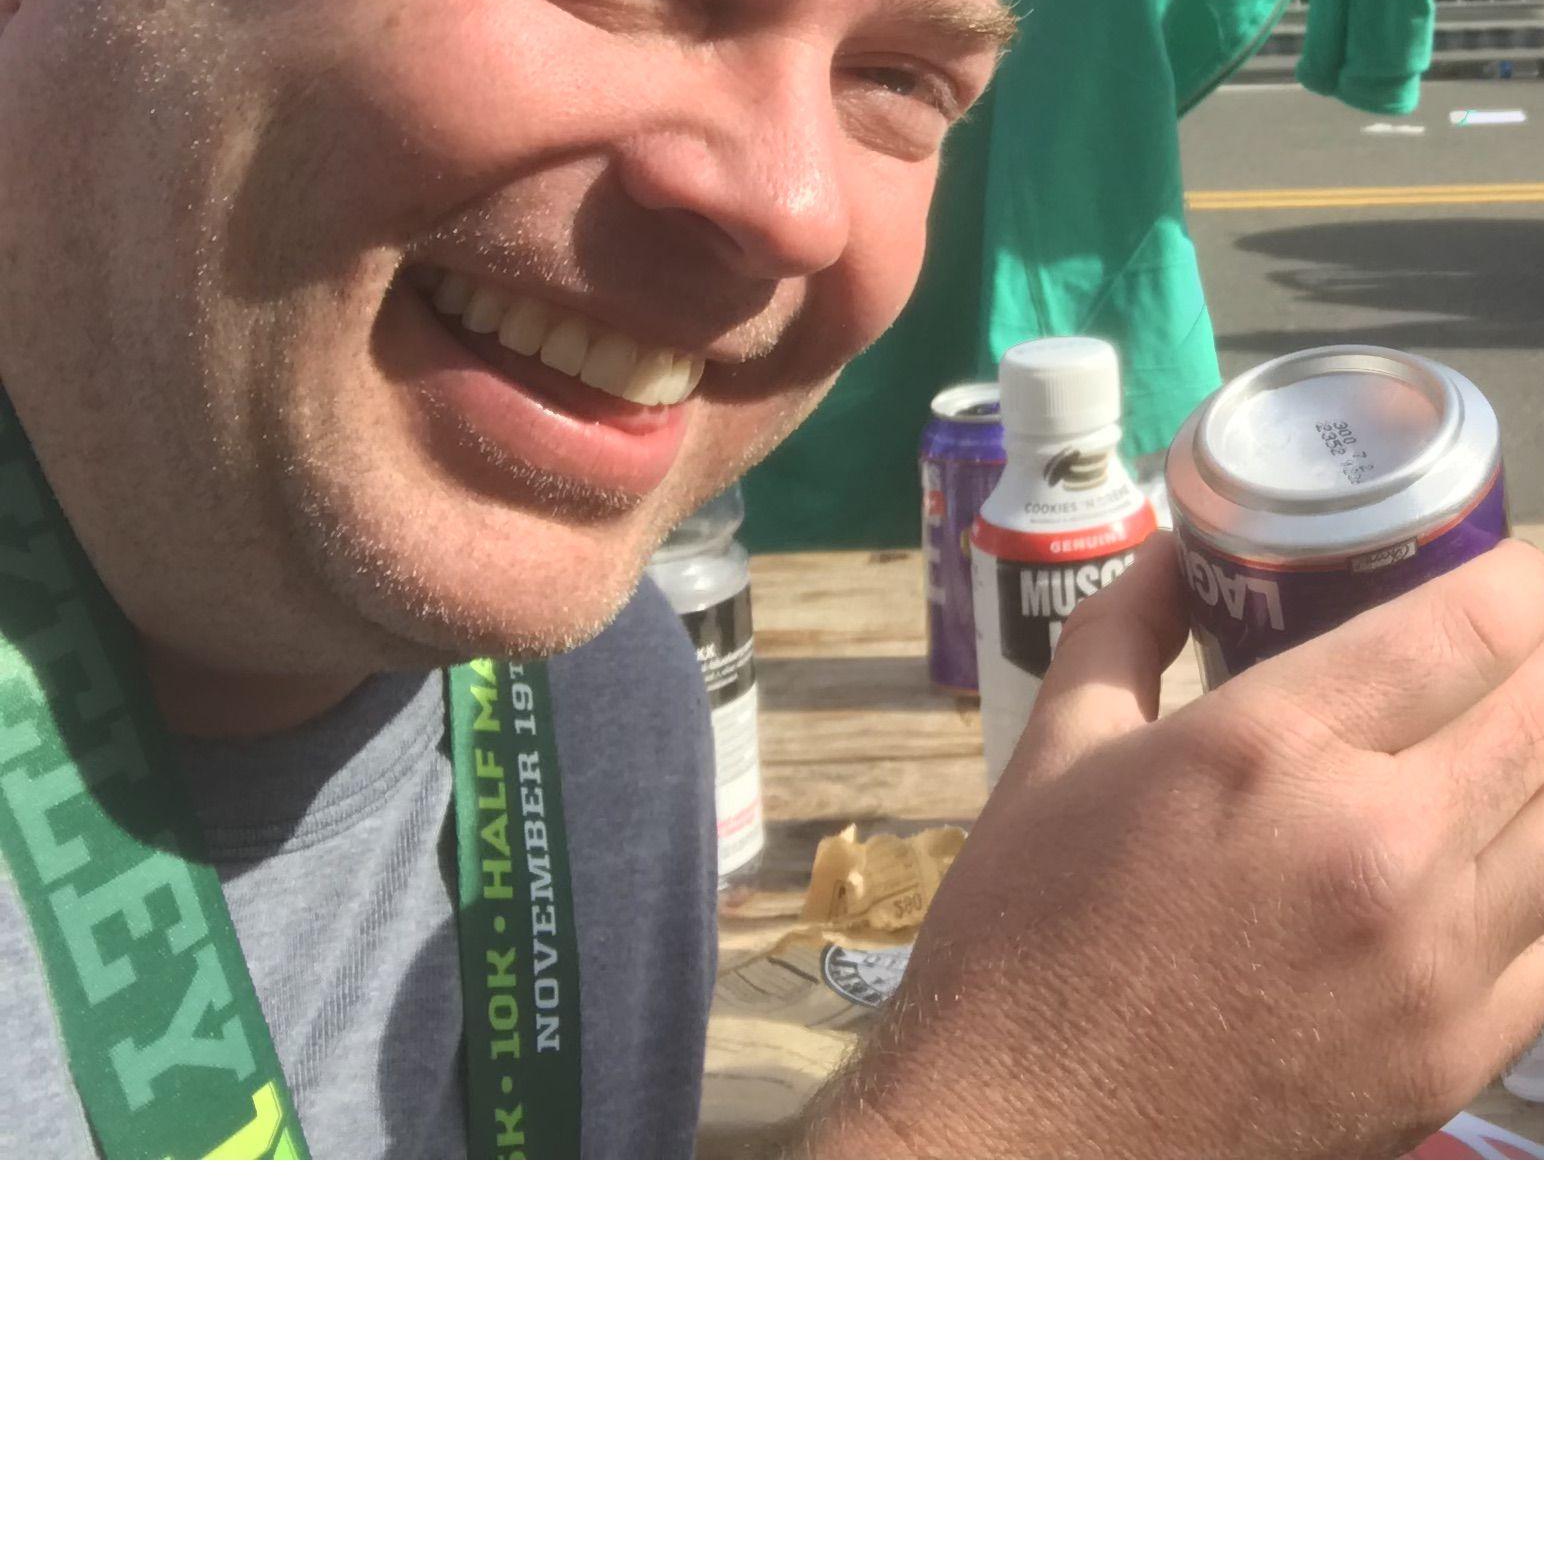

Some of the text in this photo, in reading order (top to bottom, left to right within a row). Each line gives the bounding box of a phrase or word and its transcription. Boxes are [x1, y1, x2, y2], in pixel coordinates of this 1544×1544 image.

[1024, 503, 1078, 514] COOKIES
[1177, 534, 1286, 631] LAG
[474, 748, 514, 899] HALF
[518, 750, 561, 1053] NOVEMBER
[486, 947, 521, 1060] 10K
